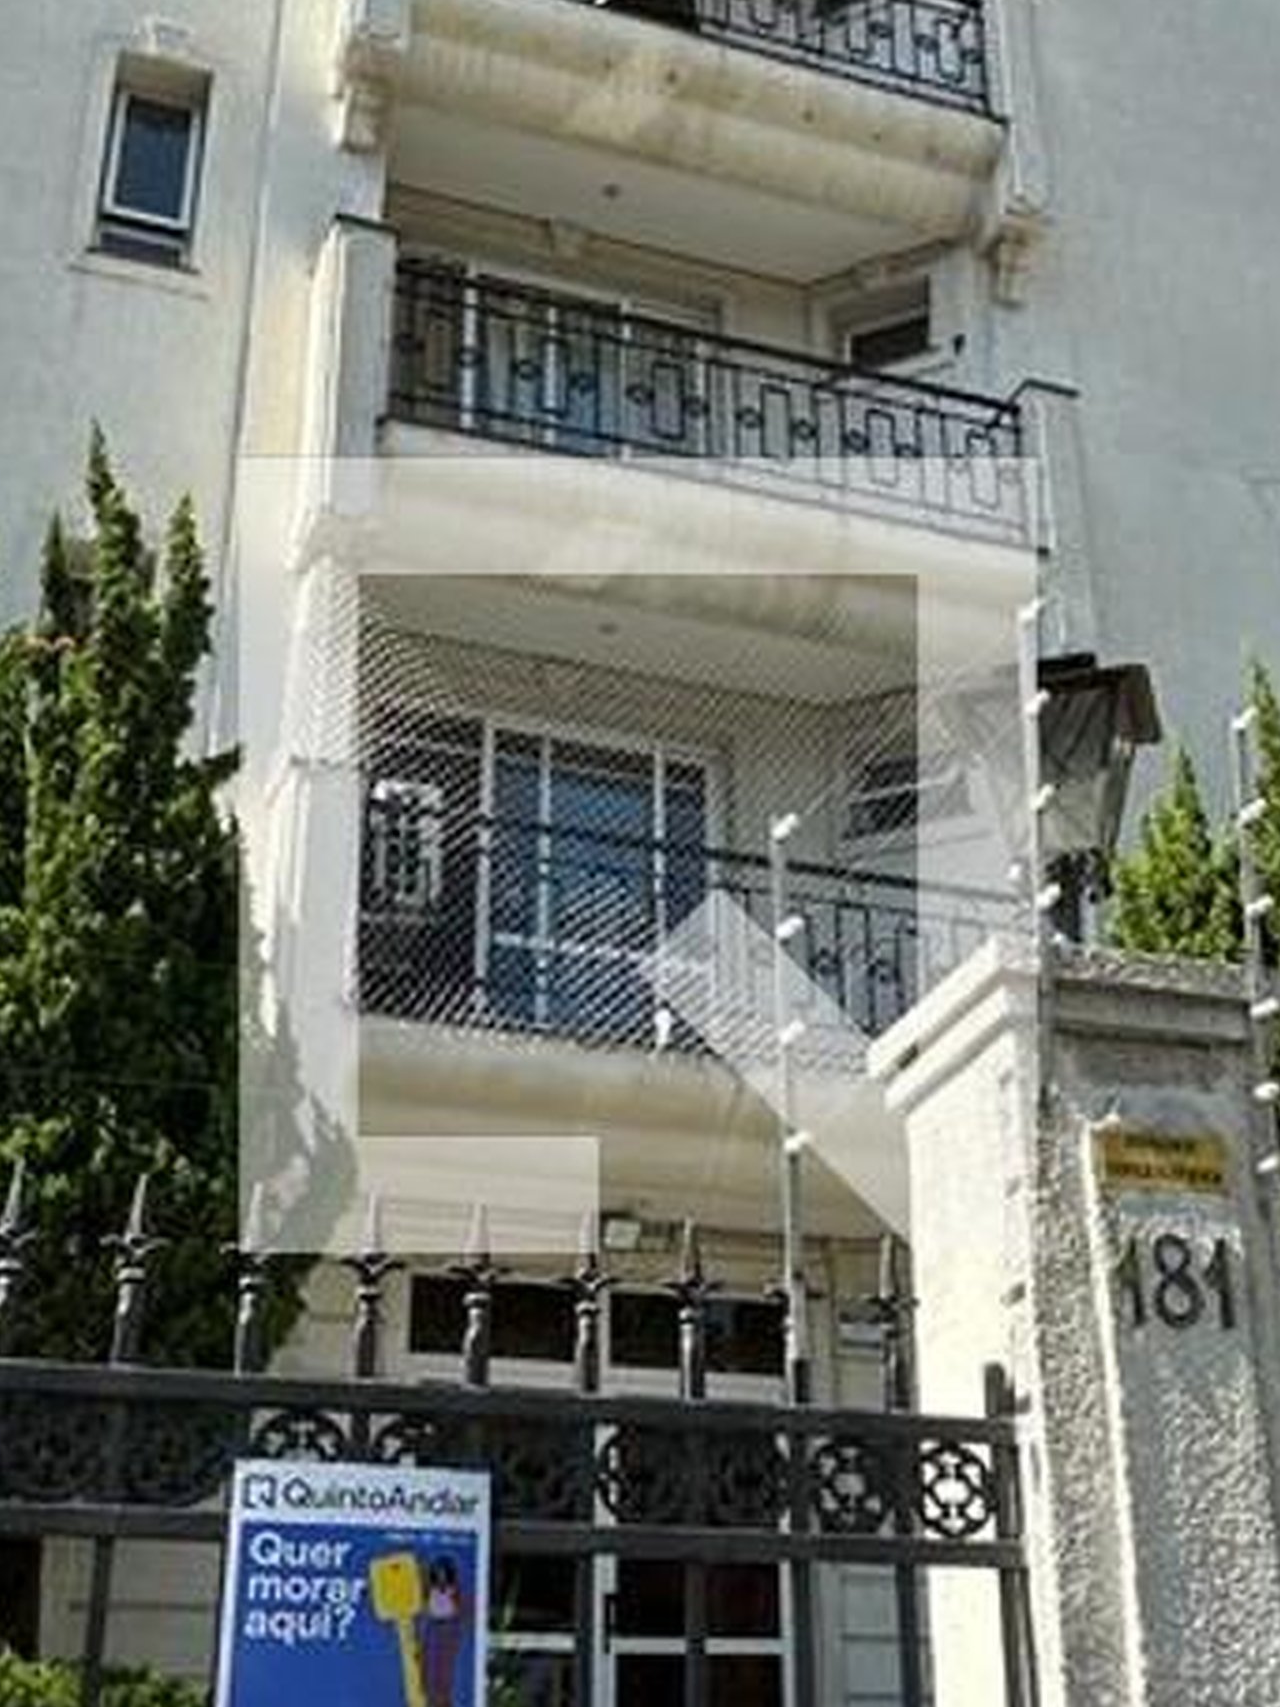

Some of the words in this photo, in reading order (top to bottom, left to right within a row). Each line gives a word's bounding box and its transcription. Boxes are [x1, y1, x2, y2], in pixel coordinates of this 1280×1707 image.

[1118, 1234, 1235, 1328] 181
[283, 1475, 478, 1515] QuintoAndar
[249, 1531, 352, 1567] Quer
[247, 1573, 366, 1602] morar
[243, 1604, 356, 1645] aqui?
